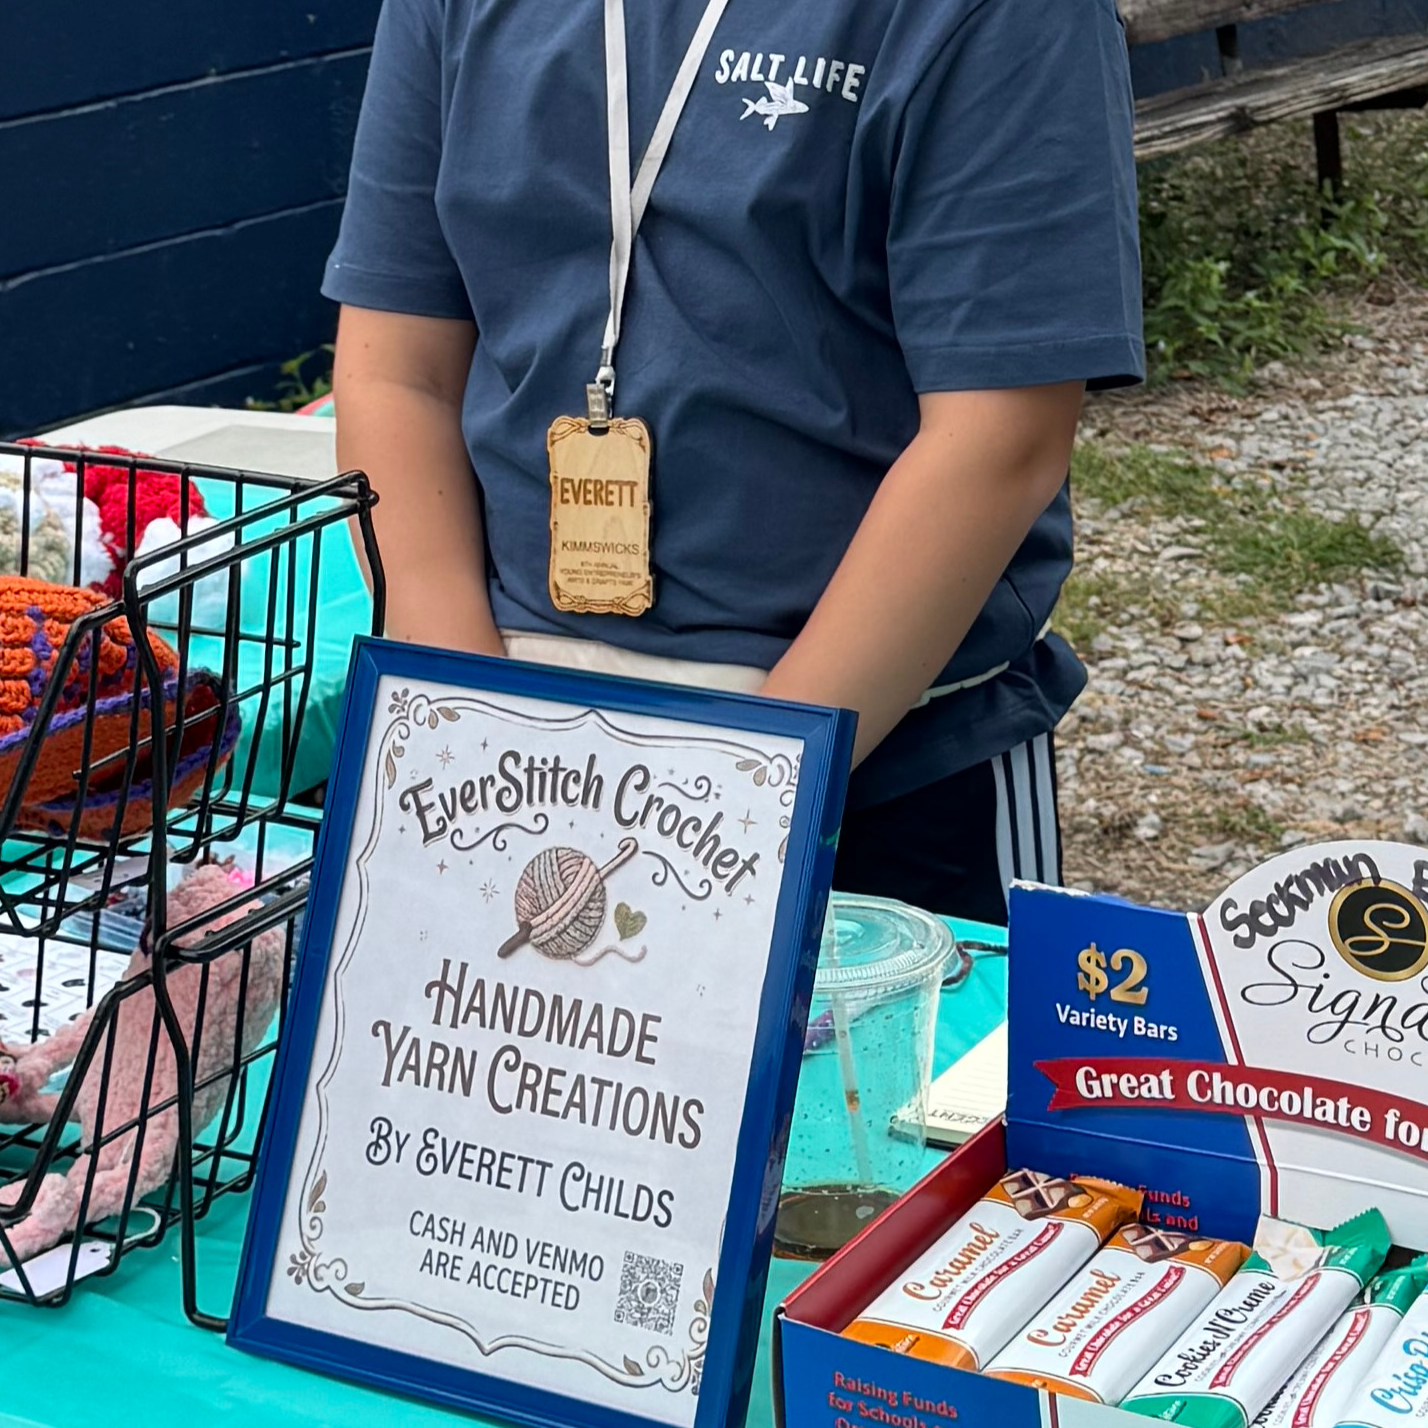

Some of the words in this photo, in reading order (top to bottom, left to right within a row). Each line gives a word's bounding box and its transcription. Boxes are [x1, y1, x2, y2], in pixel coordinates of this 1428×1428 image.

[715, 49, 786, 84] SALT
[793, 56, 866, 102] LIFE
[560, 477, 639, 507] EVERETT
[561, 541, 640, 555] KIMMSWICKS
[399, 749, 606, 847] EverStitch
[614, 764, 761, 896] Crochet
[1076, 941, 1149, 1005] $2
[425, 958, 662, 1065] HANDMADE
[1056, 1003, 1128, 1038] Variety
[1134, 1016, 1178, 1041] Bars
[372, 1020, 478, 1098] YARN
[487, 1044, 706, 1150] CREATIONS
[1075, 1065, 1176, 1100] Great
[1187, 1070, 1372, 1133] Chocolate
[416, 1127, 554, 1198] EVERETT
[560, 1161, 675, 1228] CHILDS
[409, 1210, 467, 1247] CASH
[471, 1226, 518, 1260] AND
[525, 1238, 604, 1281] VENMO
[902, 1221, 1000, 1301] Caramel
[419, 1248, 463, 1281] ARE
[467, 1261, 581, 1312] ACCEPTED
[1026, 1268, 1122, 1348] Caramel
[833, 1371, 898, 1407] Raising
[902, 1390, 958, 1419] Funds
[1153, 1339, 1221, 1388] Cookies
[828, 1391, 854, 1412] for
